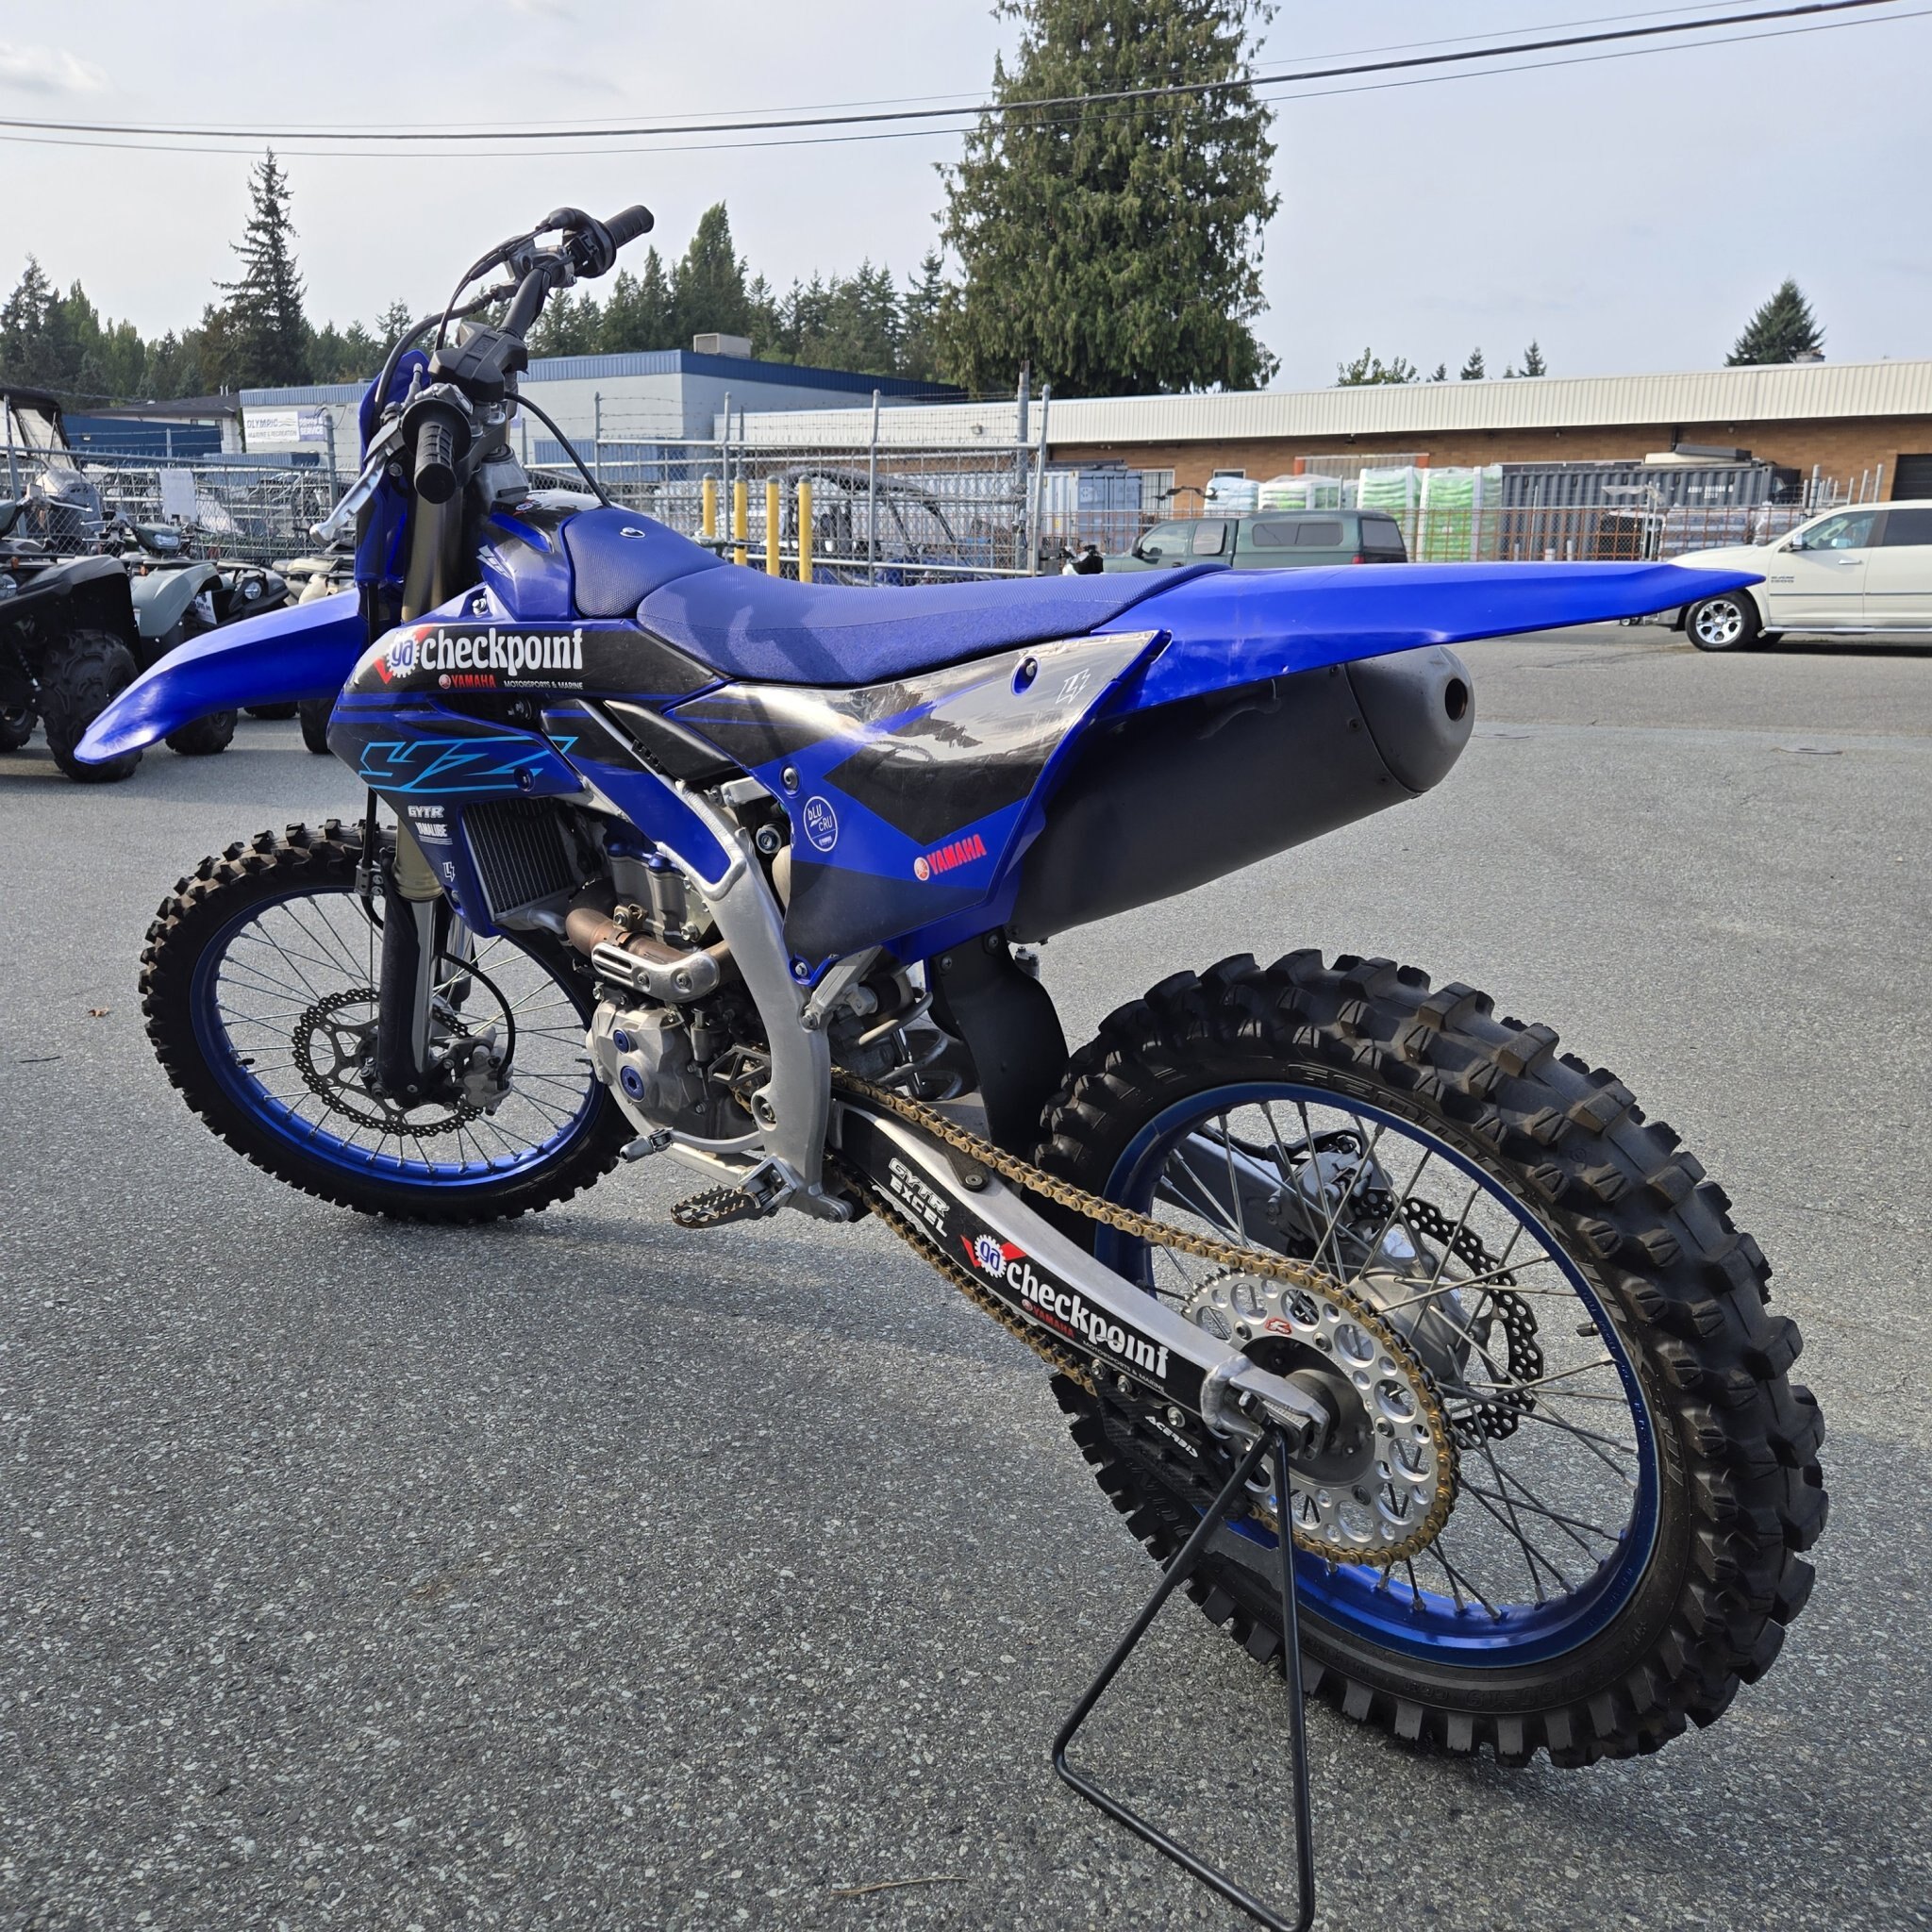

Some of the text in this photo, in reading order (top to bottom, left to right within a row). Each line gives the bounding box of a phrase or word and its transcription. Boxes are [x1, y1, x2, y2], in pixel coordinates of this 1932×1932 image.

[246, 418, 278, 429] OLYMPIC
[421, 626, 583, 676] checkpoint
[451, 674, 497, 689] YAMAHA
[504, 680, 551, 689] MOTORSPORTS
[558, 681, 583, 691] MARINE
[408, 805, 444, 819] GYTR
[926, 833, 988, 875] YAMAHA
[888, 1157, 951, 1218] GYTR
[889, 1174, 948, 1238] EXCEL
[1006, 1261, 1169, 1379] checkpoint
[1033, 1305, 1075, 1340] YAMAHA
[1083, 1340, 1132, 1374] MOTORSPORTS
[1139, 1372, 1166, 1392] MARINE
[1145, 1415, 1199, 1458] ACERBIS
